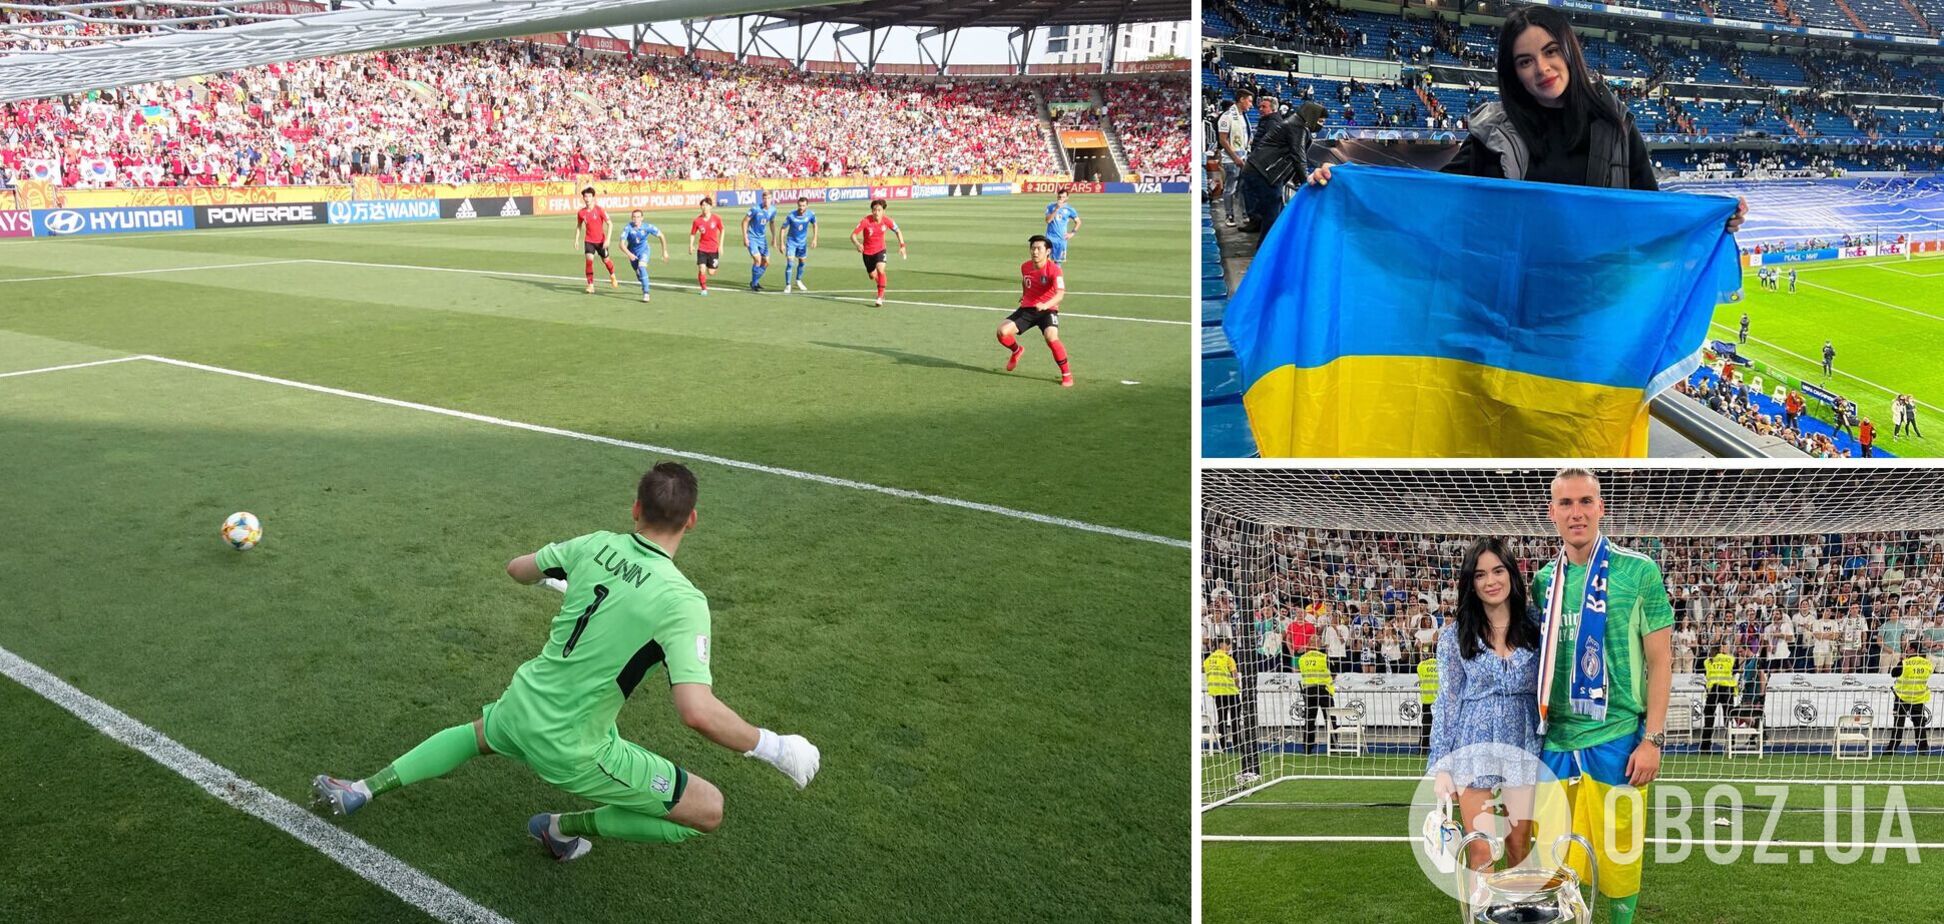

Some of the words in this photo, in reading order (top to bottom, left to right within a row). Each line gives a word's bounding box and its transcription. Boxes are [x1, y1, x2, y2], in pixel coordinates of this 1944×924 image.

[289, 4, 321, 13] WORLD
[1576, 2, 1593, 10] Madrid
[1036, 182, 1055, 193] 100
[1057, 182, 1093, 193] YEARS
[1134, 182, 1162, 193] VISA
[736, 190, 756, 205] VISA
[773, 189, 798, 202] QATAR
[798, 188, 825, 200] AIRWAYS
[550, 197, 571, 211] FIFA
[599, 195, 629, 208] WORLD
[632, 195, 649, 207] CUP
[651, 194, 684, 206] POLAND
[90, 209, 183, 230] HYUNDAI
[1845, 248, 1867, 257] FedEx
[1880, 246, 1900, 255] FedEx
[593, 544, 652, 589] LUNIN
[562, 583, 610, 659] 1
